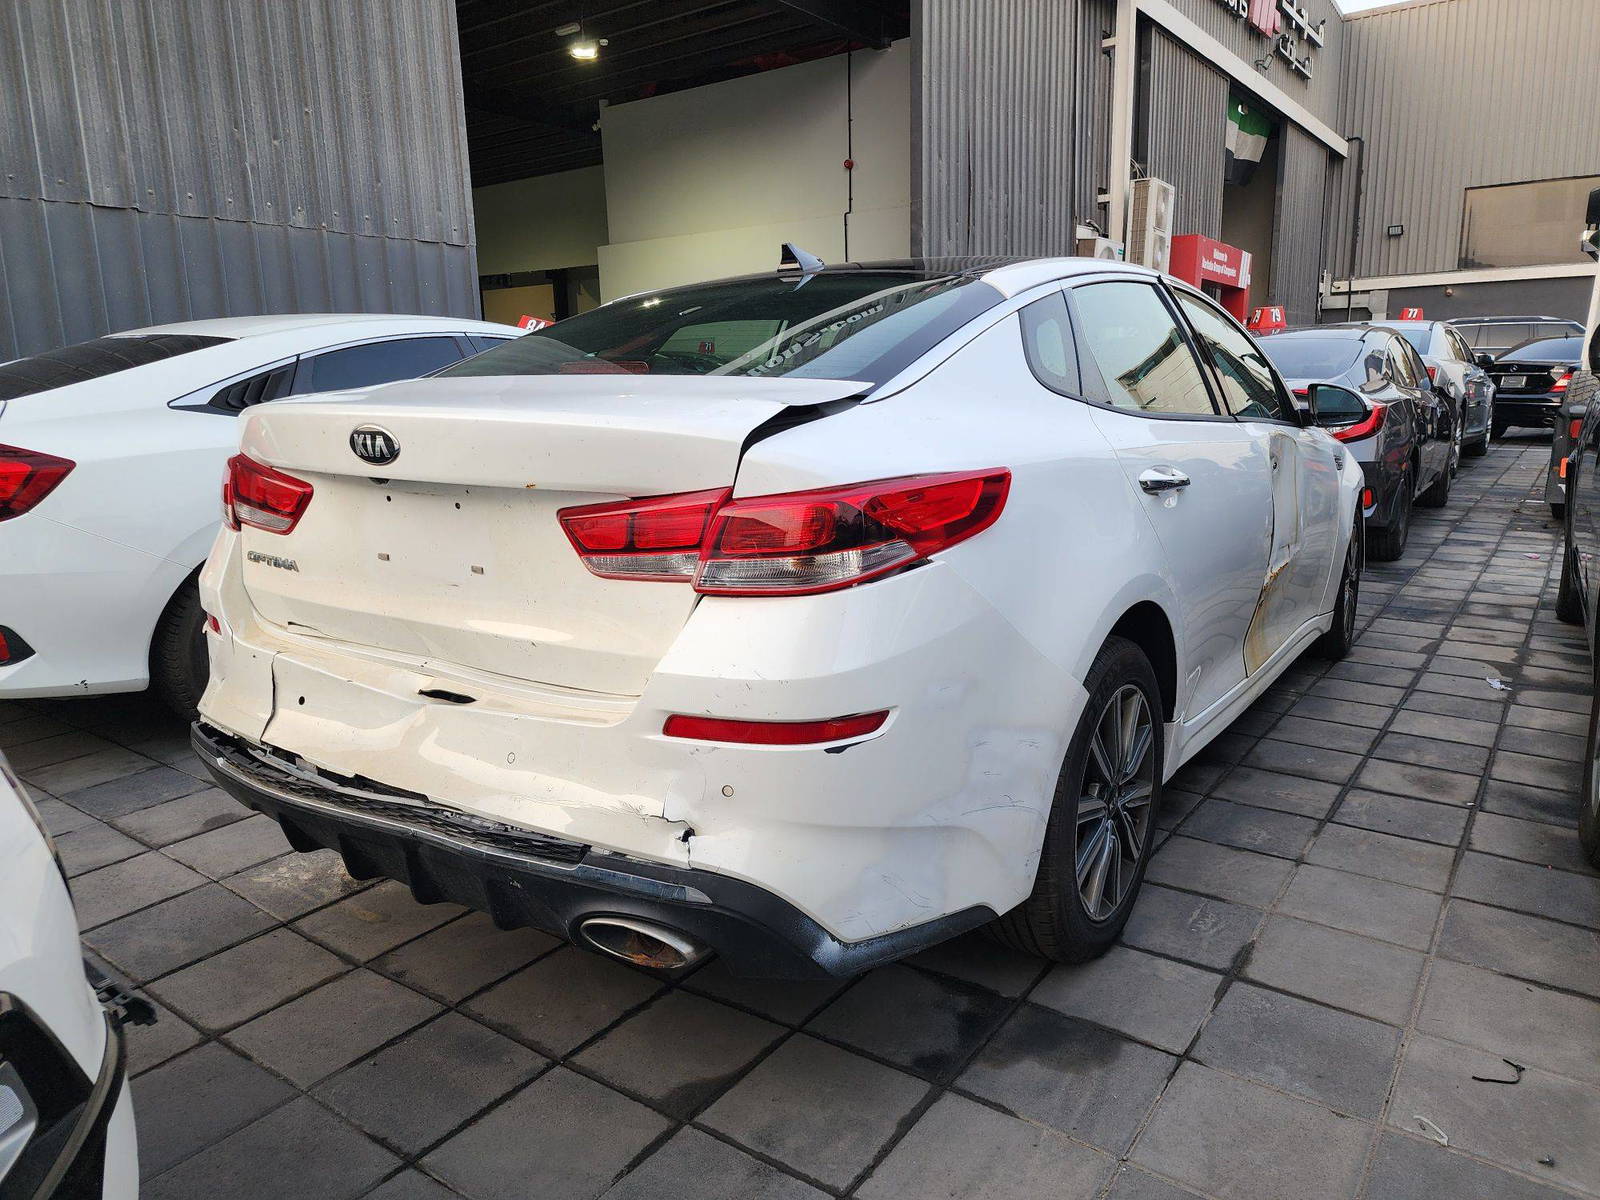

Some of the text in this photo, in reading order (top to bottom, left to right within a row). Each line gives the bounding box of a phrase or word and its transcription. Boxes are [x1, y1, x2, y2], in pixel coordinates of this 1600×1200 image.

[1270, 307, 1282, 322] 79
[1407, 308, 1418, 319] 77
[353, 433, 391, 458] KIA
[246, 550, 300, 573] OPTIMA
